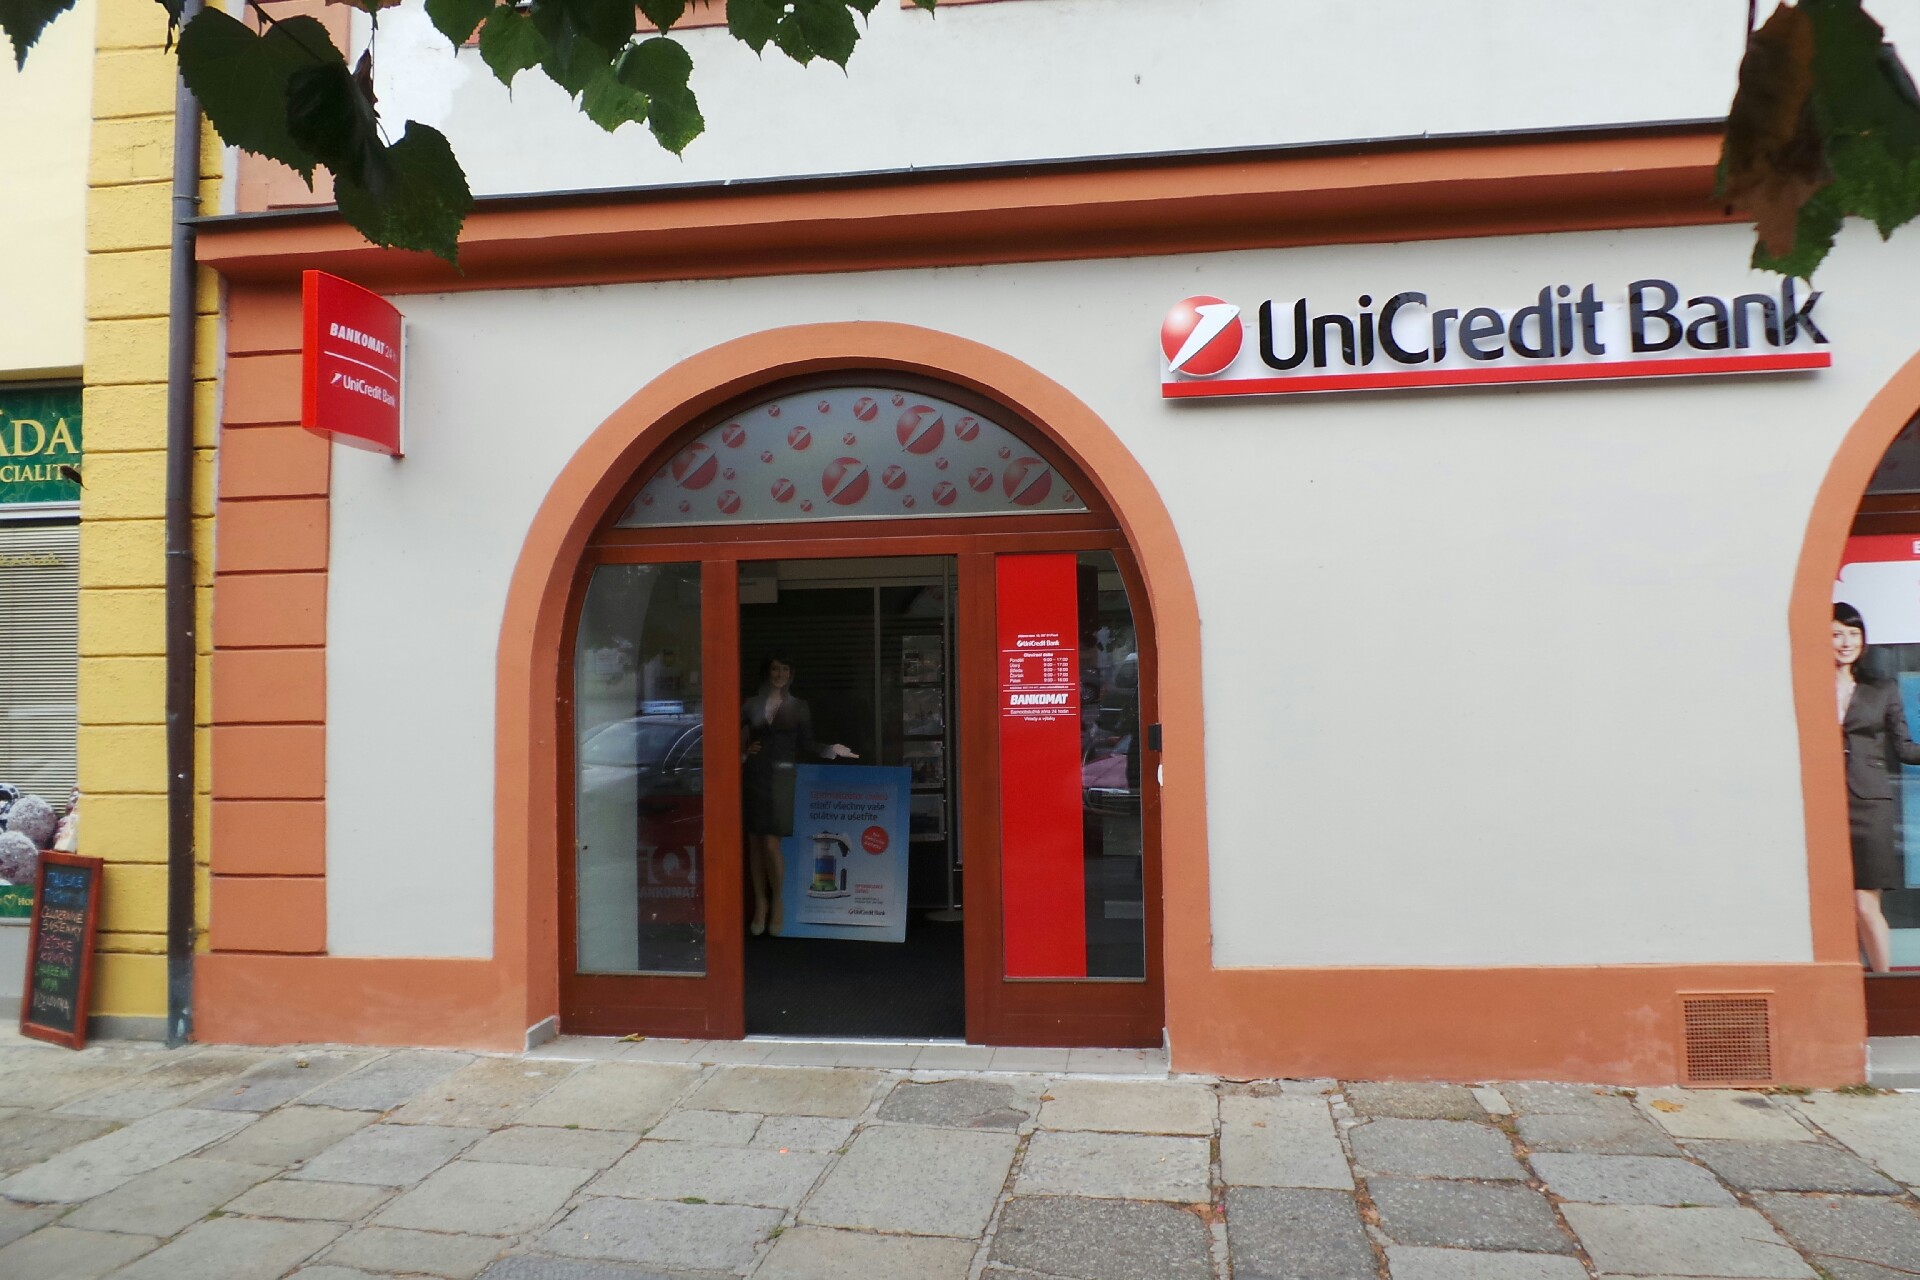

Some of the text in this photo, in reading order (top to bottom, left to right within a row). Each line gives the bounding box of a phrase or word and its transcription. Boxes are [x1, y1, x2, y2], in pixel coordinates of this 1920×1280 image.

[329, 322, 385, 356] BANKOMAT
[1258, 276, 1829, 371] UniCredit Bank
[343, 374, 396, 408] UniCredit Bank
[1010, 694, 1069, 705] BANKOMAT
